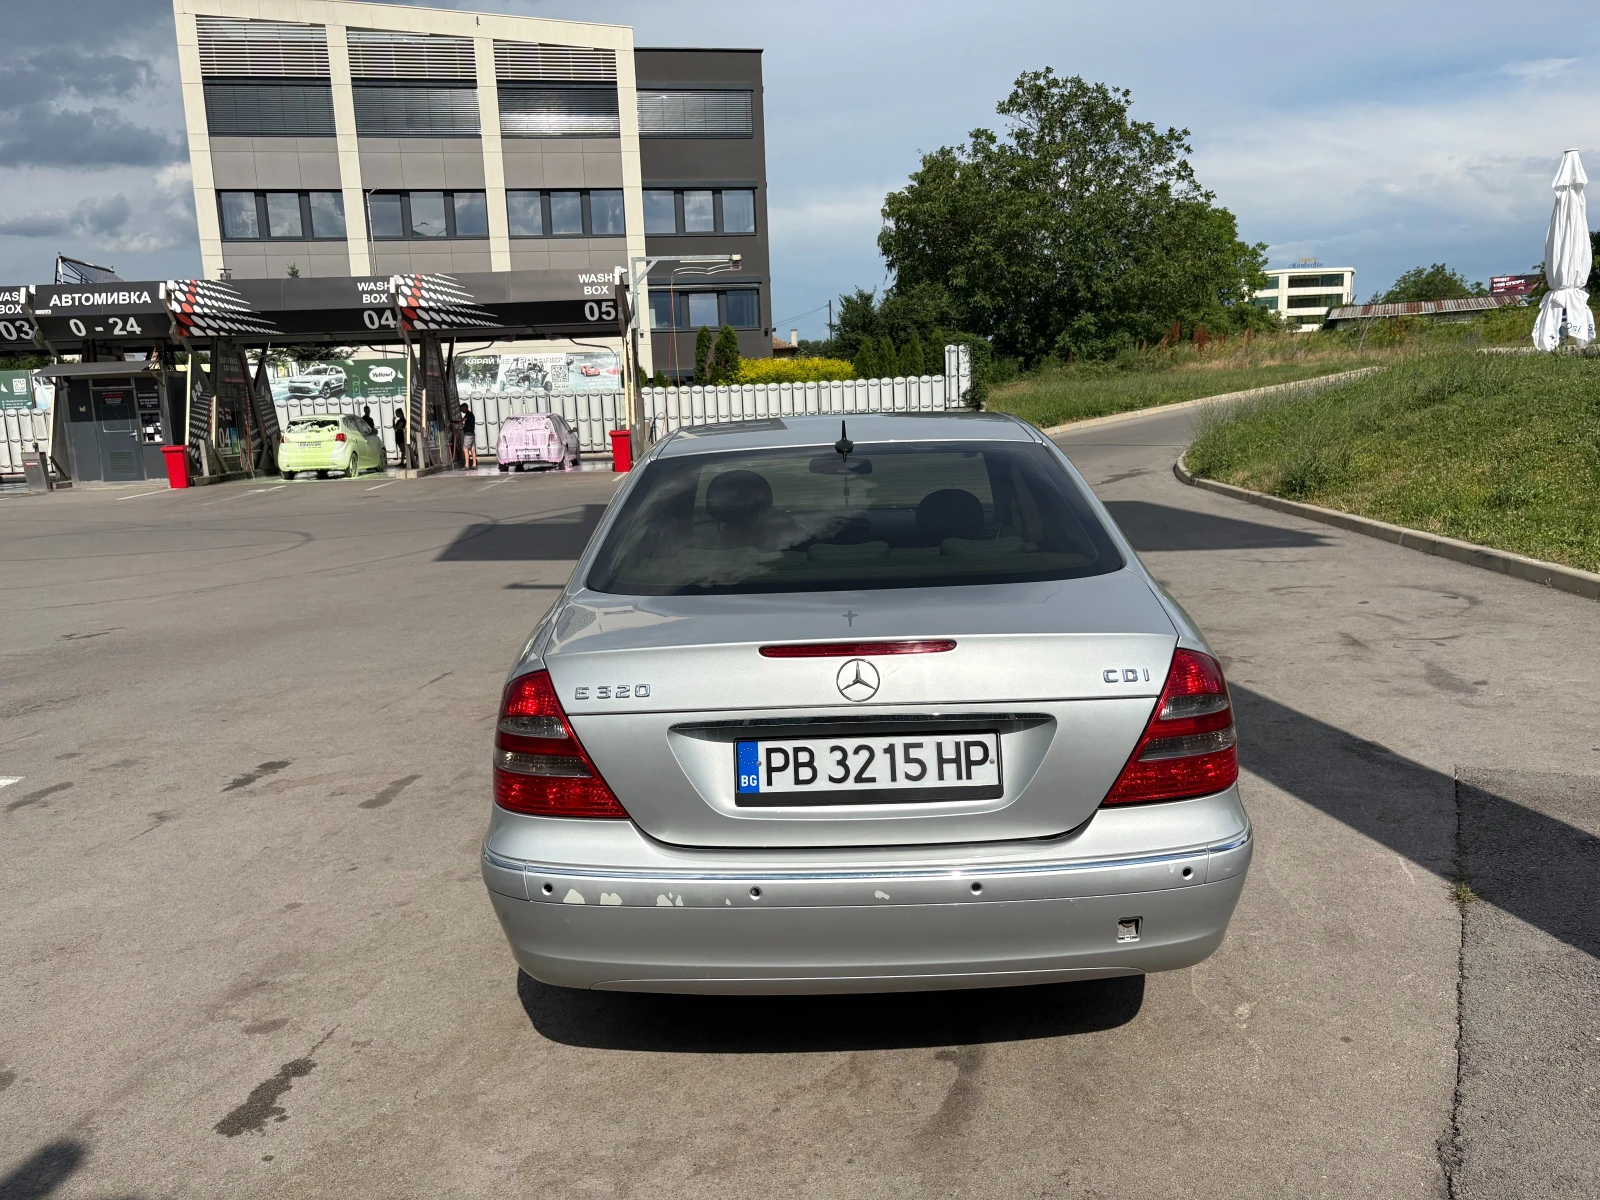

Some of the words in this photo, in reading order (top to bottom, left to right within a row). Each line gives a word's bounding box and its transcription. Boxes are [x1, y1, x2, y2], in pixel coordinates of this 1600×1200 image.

[578, 273, 613, 283] WASH
[357, 281, 391, 291] WASH
[584, 286, 609, 295] BOX
[0, 291, 20, 301] AS
[49, 291, 152, 307] АВТОМИВКА
[362, 293, 388, 304] BOX
[584, 301, 616, 321] 05
[69, 318, 87, 337] 0
[108, 317, 142, 335] 24
[363, 310, 397, 330] 04
[0, 320, 34, 341] 03
[465, 357, 495, 365] КАРАЙ
[218, 427, 232, 448] 04
[1103, 668, 1150, 683] CDI
[575, 687, 590, 700] E
[596, 684, 651, 699] 320
[765, 747, 819, 787] PB
[828, 743, 928, 784] 3215
[936, 740, 990, 781] HP
[740, 775, 758, 788] BG
